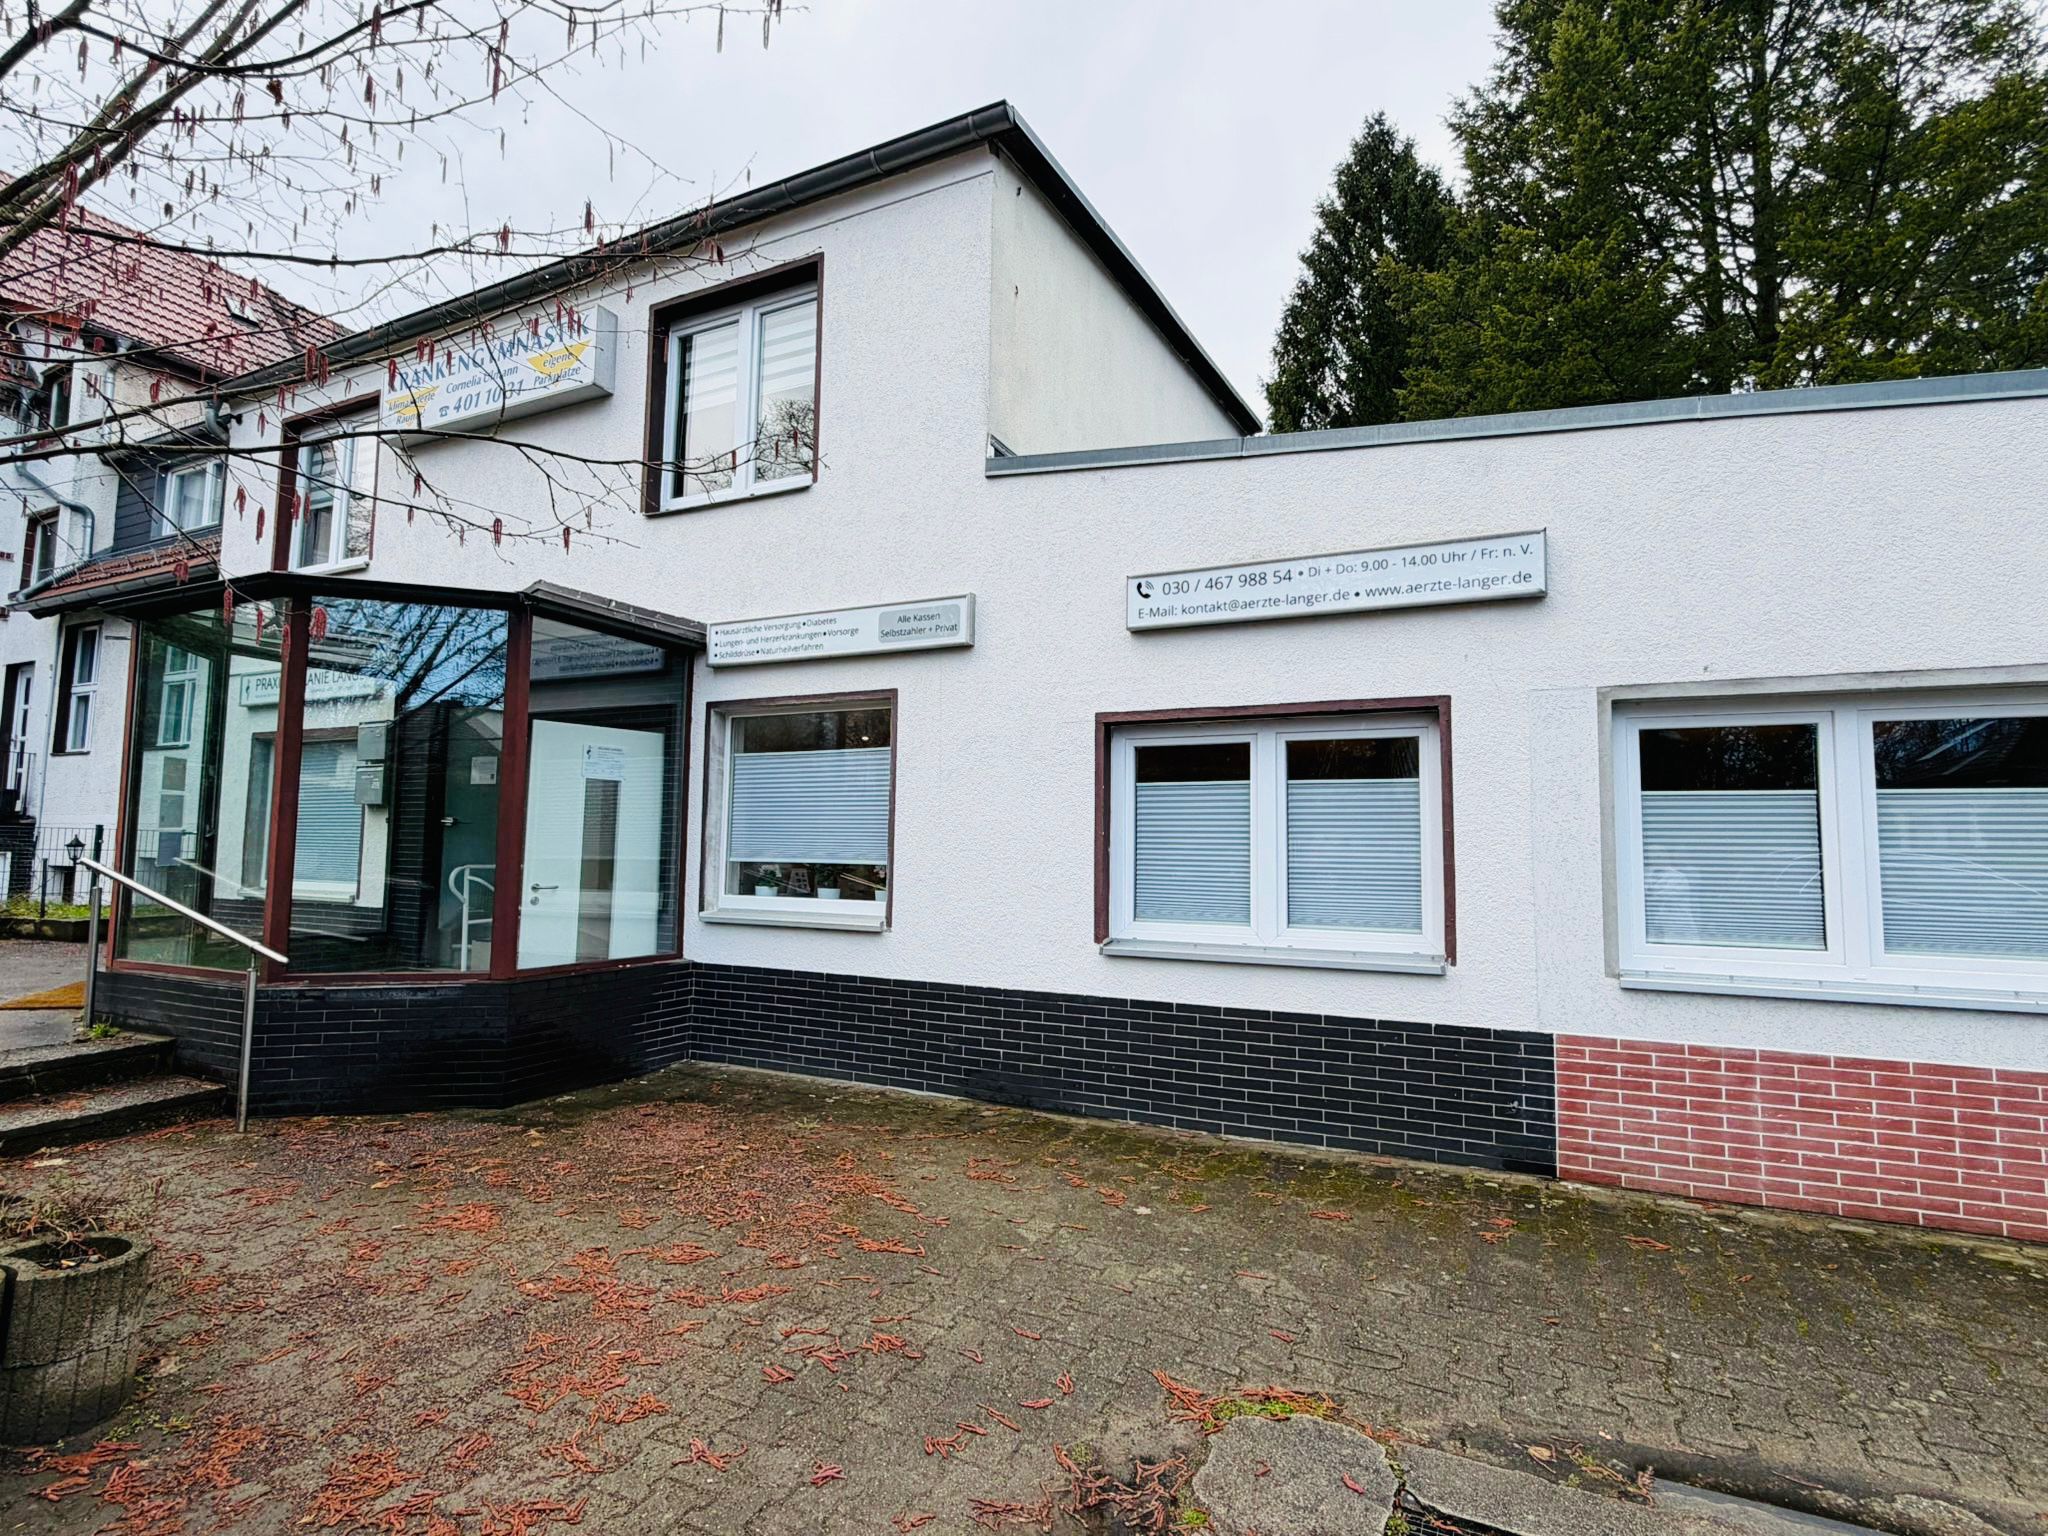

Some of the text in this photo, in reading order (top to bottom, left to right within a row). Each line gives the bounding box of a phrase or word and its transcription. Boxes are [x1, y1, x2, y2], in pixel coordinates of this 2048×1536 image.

[543, 352, 574, 368] eigene
[446, 376, 481, 394] Cornelia
[534, 366, 581, 386] Parkplätze
[453, 379, 524, 413] 401 10 31
[1162, 580, 1190, 596] 030
[1194, 579, 1201, 592] /
[1205, 575, 1233, 591] 467
[1238, 571, 1268, 588] 988
[1273, 569, 1292, 584] 54
[1308, 566, 1321, 577] Di
[1336, 563, 1357, 575] Do:
[1361, 559, 1388, 572] 9.00
[1402, 553, 1437, 568] 14.00
[1442, 549, 1466, 564] Uhr
[1470, 549, 1477, 561] /
[1481, 547, 1498, 560] Fr:
[1503, 548, 1516, 558] n.
[1520, 544, 1533, 555] V.
[1138, 571, 1532, 619] E-Mail: kontakt@aerzte-langer.de www.aerzte-langer.de
[720, 617, 837, 636] Hausärztliche Versorgung Diabetes
[897, 613, 940, 624] Alle Kassen
[720, 627, 859, 649] Lungen- und Herzerkrankungen Vorsorge
[880, 627, 926, 638] Selbstzahler
[935, 623, 957, 633] Privat
[719, 643, 824, 658] Schilddrüse Naturheilverfahren
